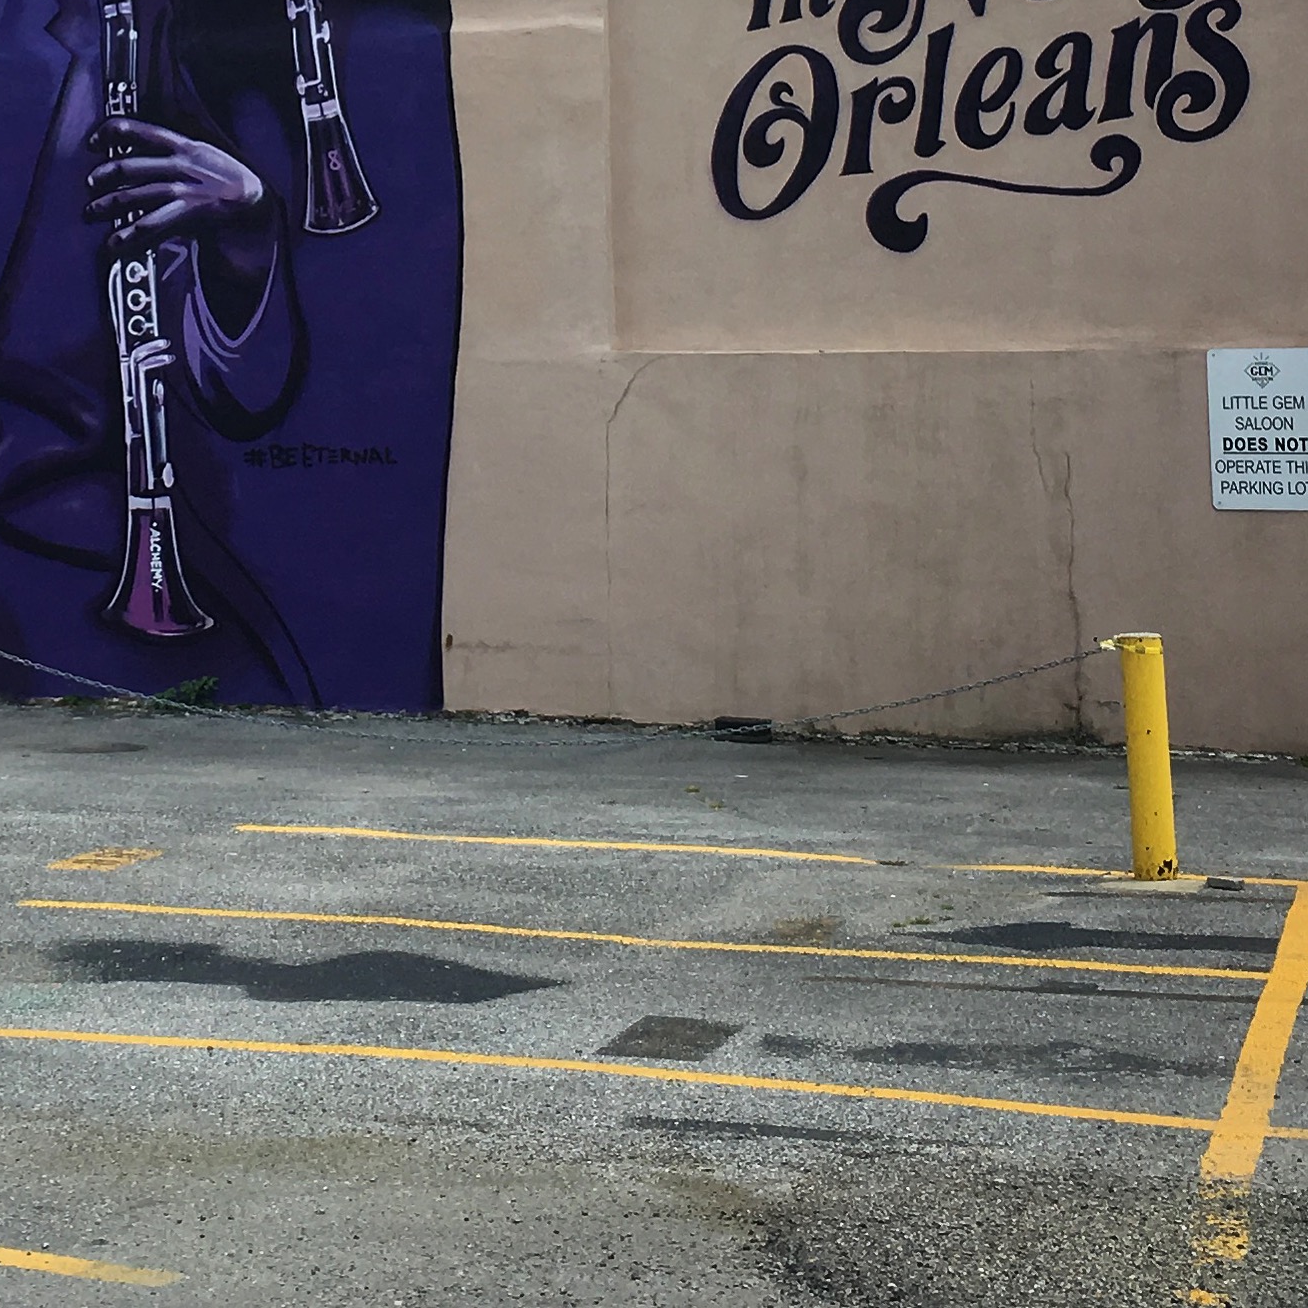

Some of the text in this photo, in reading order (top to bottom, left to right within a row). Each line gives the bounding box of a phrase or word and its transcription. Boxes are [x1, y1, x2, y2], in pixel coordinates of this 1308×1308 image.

[1222, 396, 1305, 410] LITTLE GEM
[1235, 416, 1294, 431] SALOON
[1222, 437, 1308, 452] DOES NOT
[1215, 459, 1282, 474] OPERATE
[1220, 480, 1284, 495] PARKING
